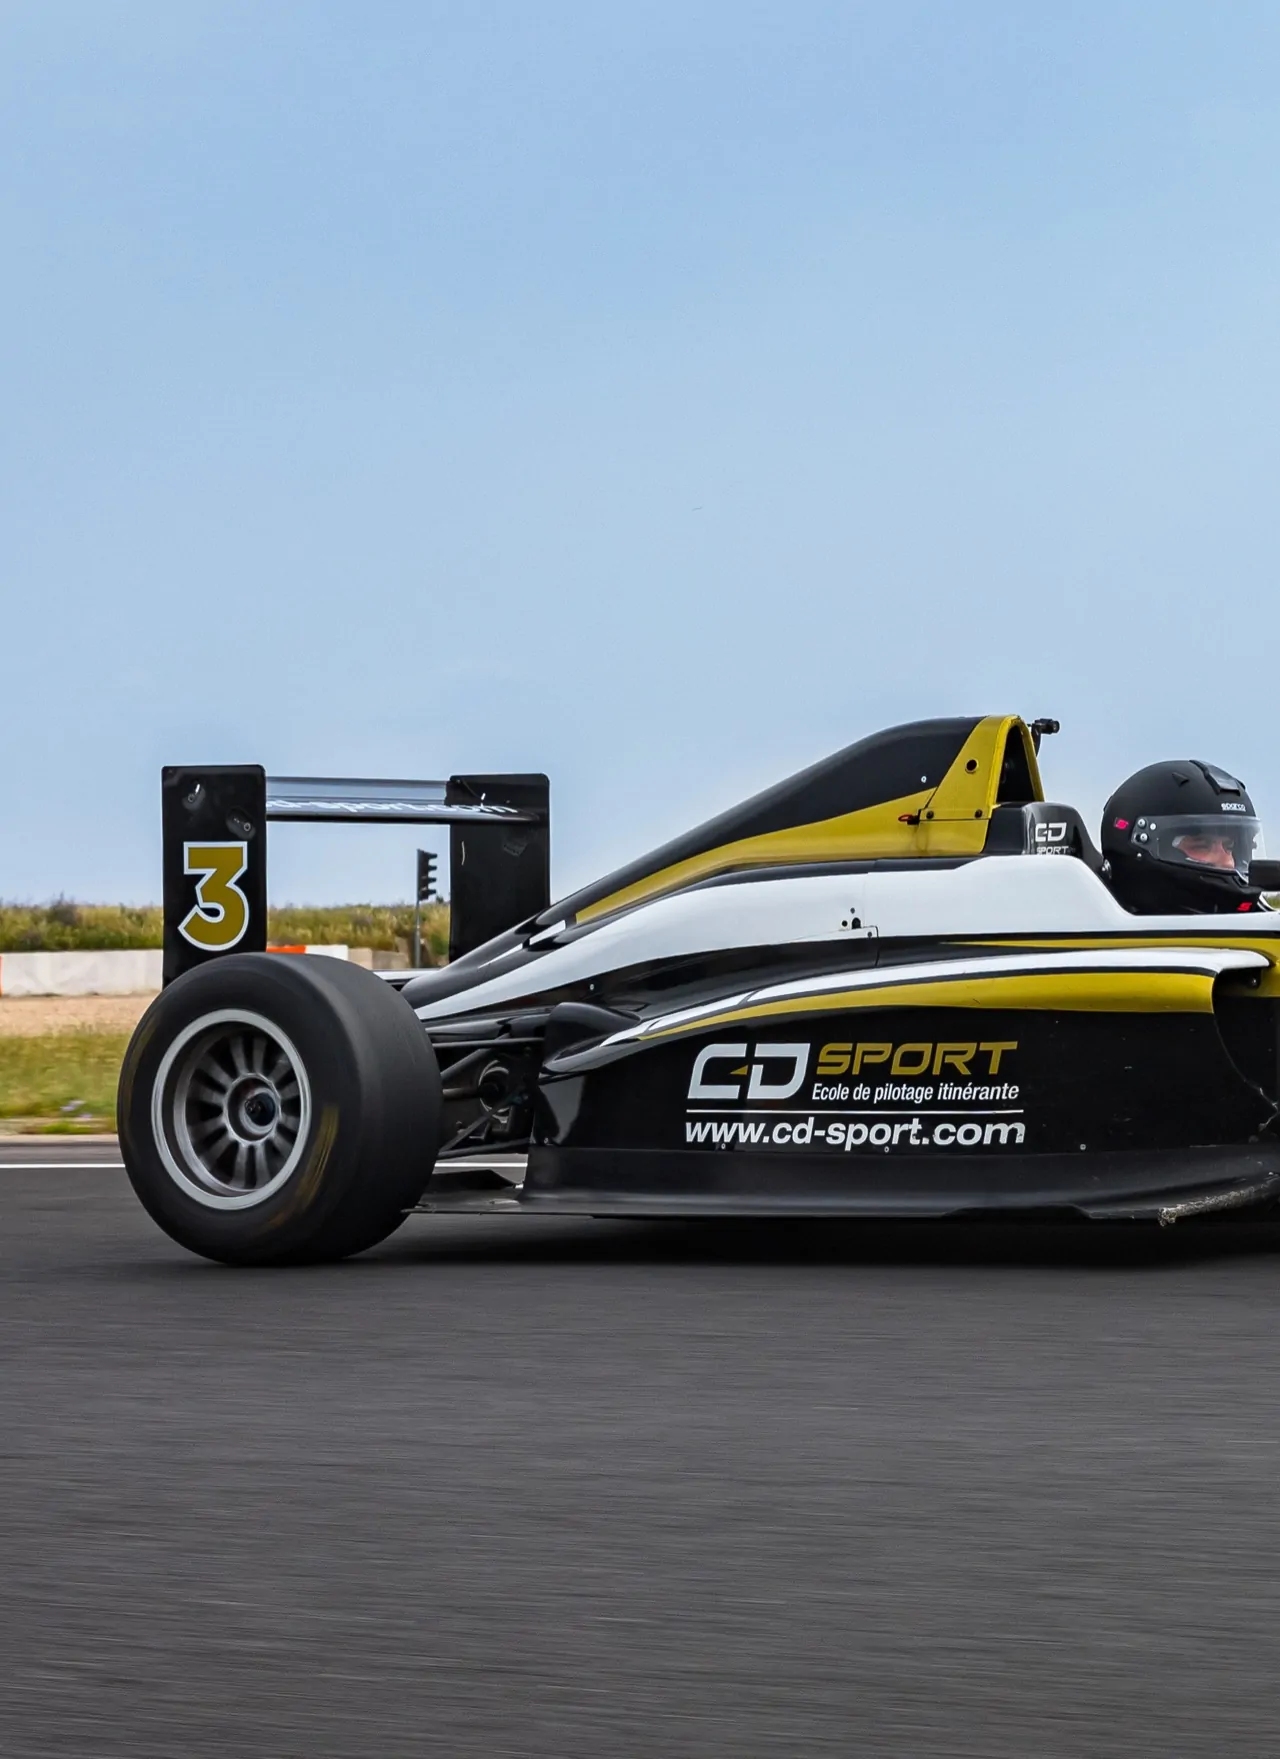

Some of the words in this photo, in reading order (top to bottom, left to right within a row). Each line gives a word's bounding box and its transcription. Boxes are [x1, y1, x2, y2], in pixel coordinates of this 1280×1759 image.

[1035, 822, 1067, 842] CD
[177, 841, 250, 952] 3
[687, 1042, 811, 1100] CD
[816, 1041, 1018, 1076] SPORT
[811, 1083, 851, 1100] Ecole
[852, 1083, 871, 1100] de
[873, 1083, 934, 1104] pilotage
[937, 1082, 1020, 1100] itinérante
[685, 1117, 1026, 1151] www.cd-sport.com
